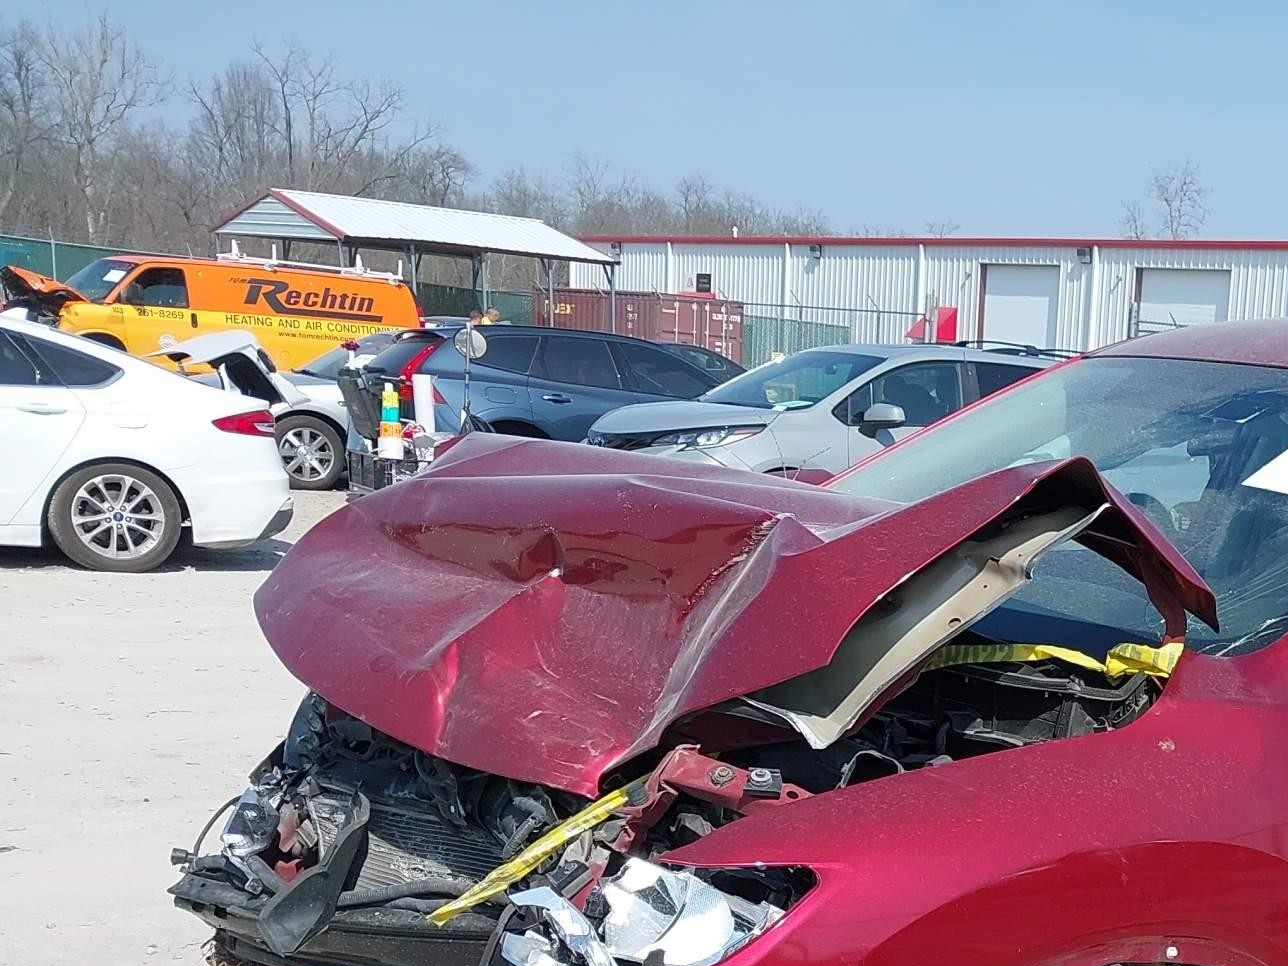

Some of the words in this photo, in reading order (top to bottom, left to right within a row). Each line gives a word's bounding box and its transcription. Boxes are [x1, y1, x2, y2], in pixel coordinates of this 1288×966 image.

[243, 278, 383, 322] Rechtin
[225, 314, 273, 327] HEATING
[278, 318, 300, 329] AND
[305, 320, 323, 331] AIR
